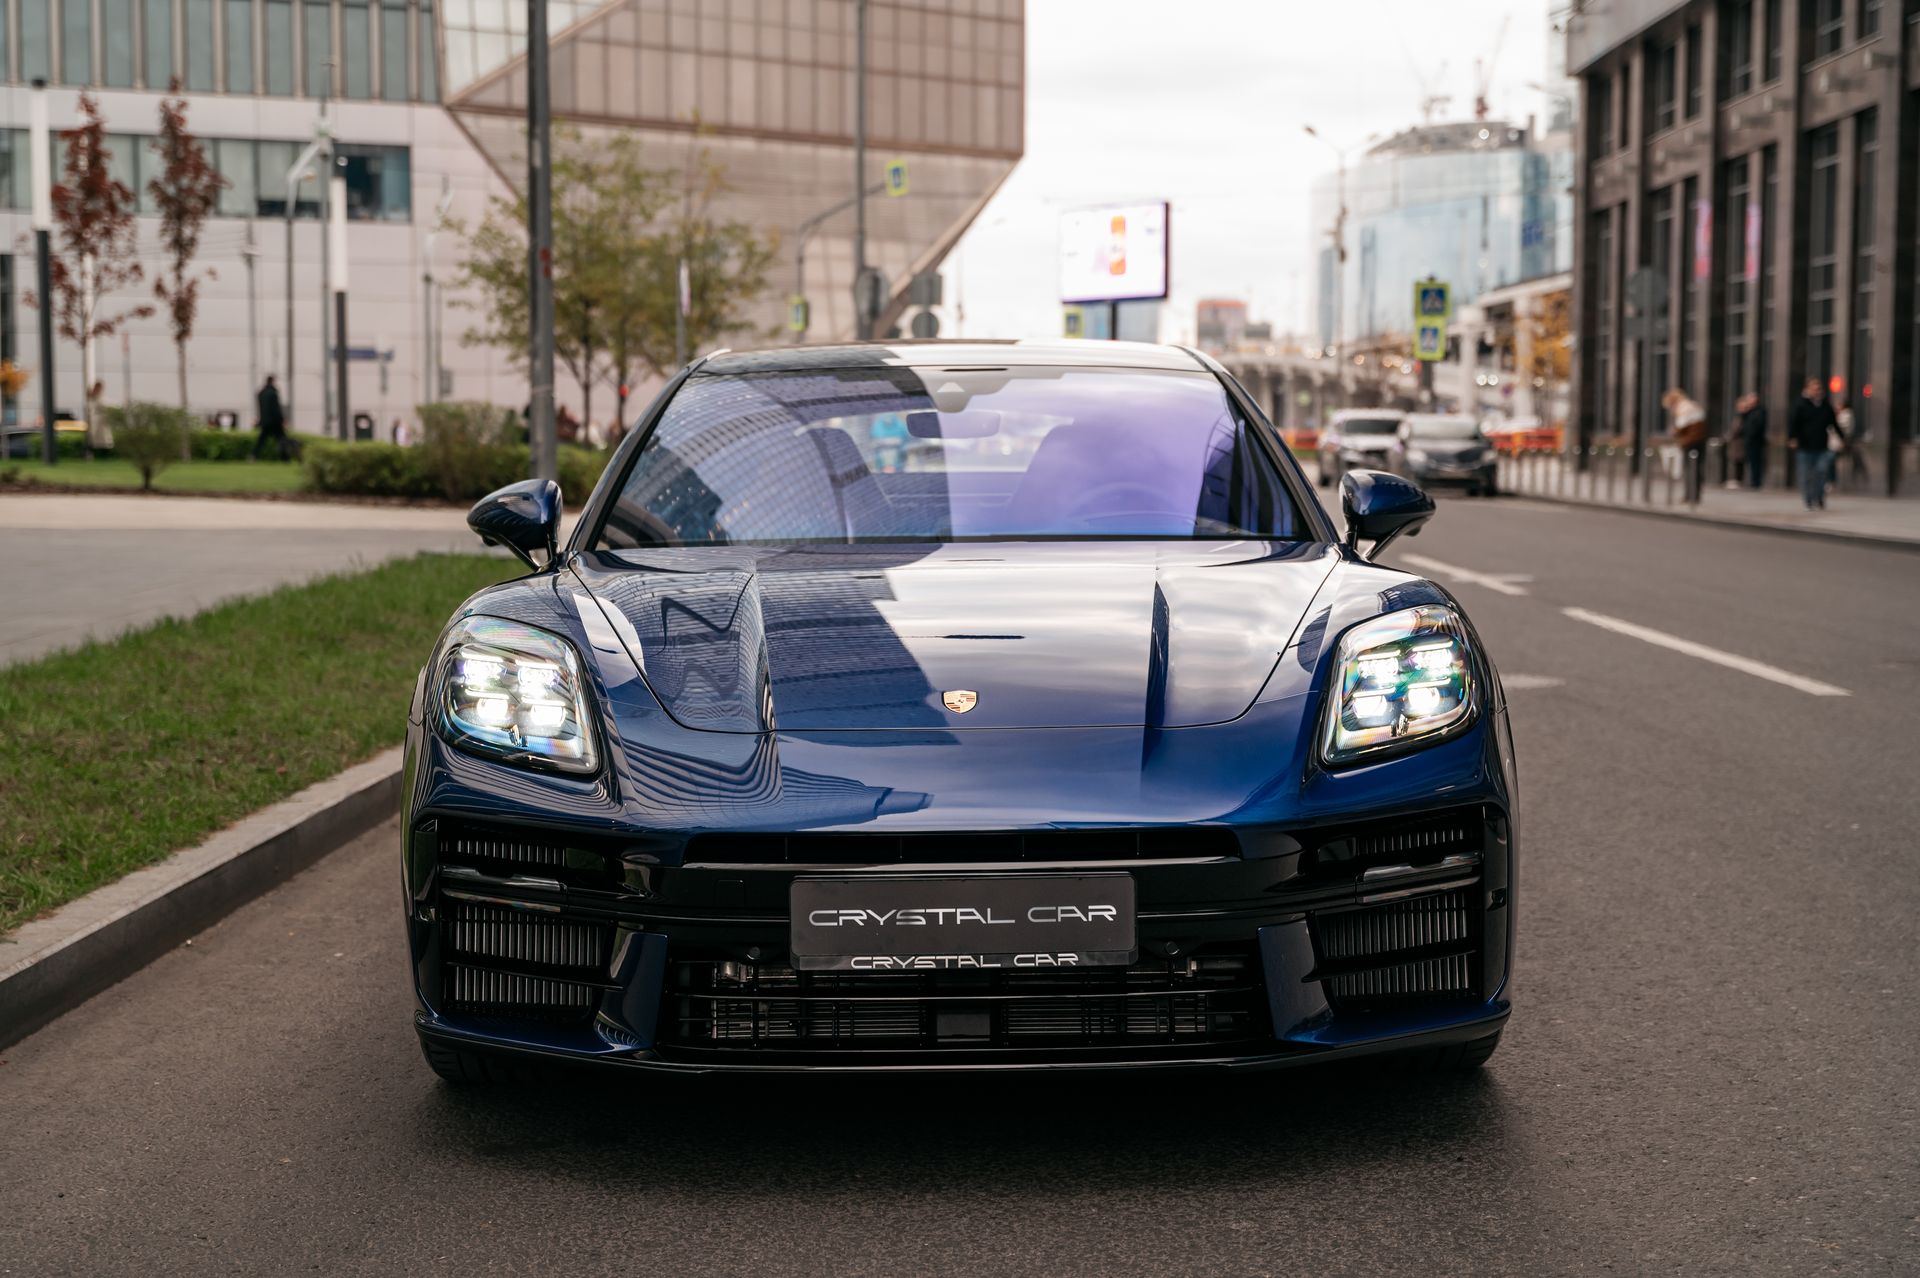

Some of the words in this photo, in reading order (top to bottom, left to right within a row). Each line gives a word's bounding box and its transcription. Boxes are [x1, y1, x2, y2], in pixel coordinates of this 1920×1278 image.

[808, 907, 1016, 927] CRYSTAL
[1027, 904, 1118, 923] CAR
[850, 955, 1001, 970] CRYSTAL
[1013, 952, 1080, 968] CAR
